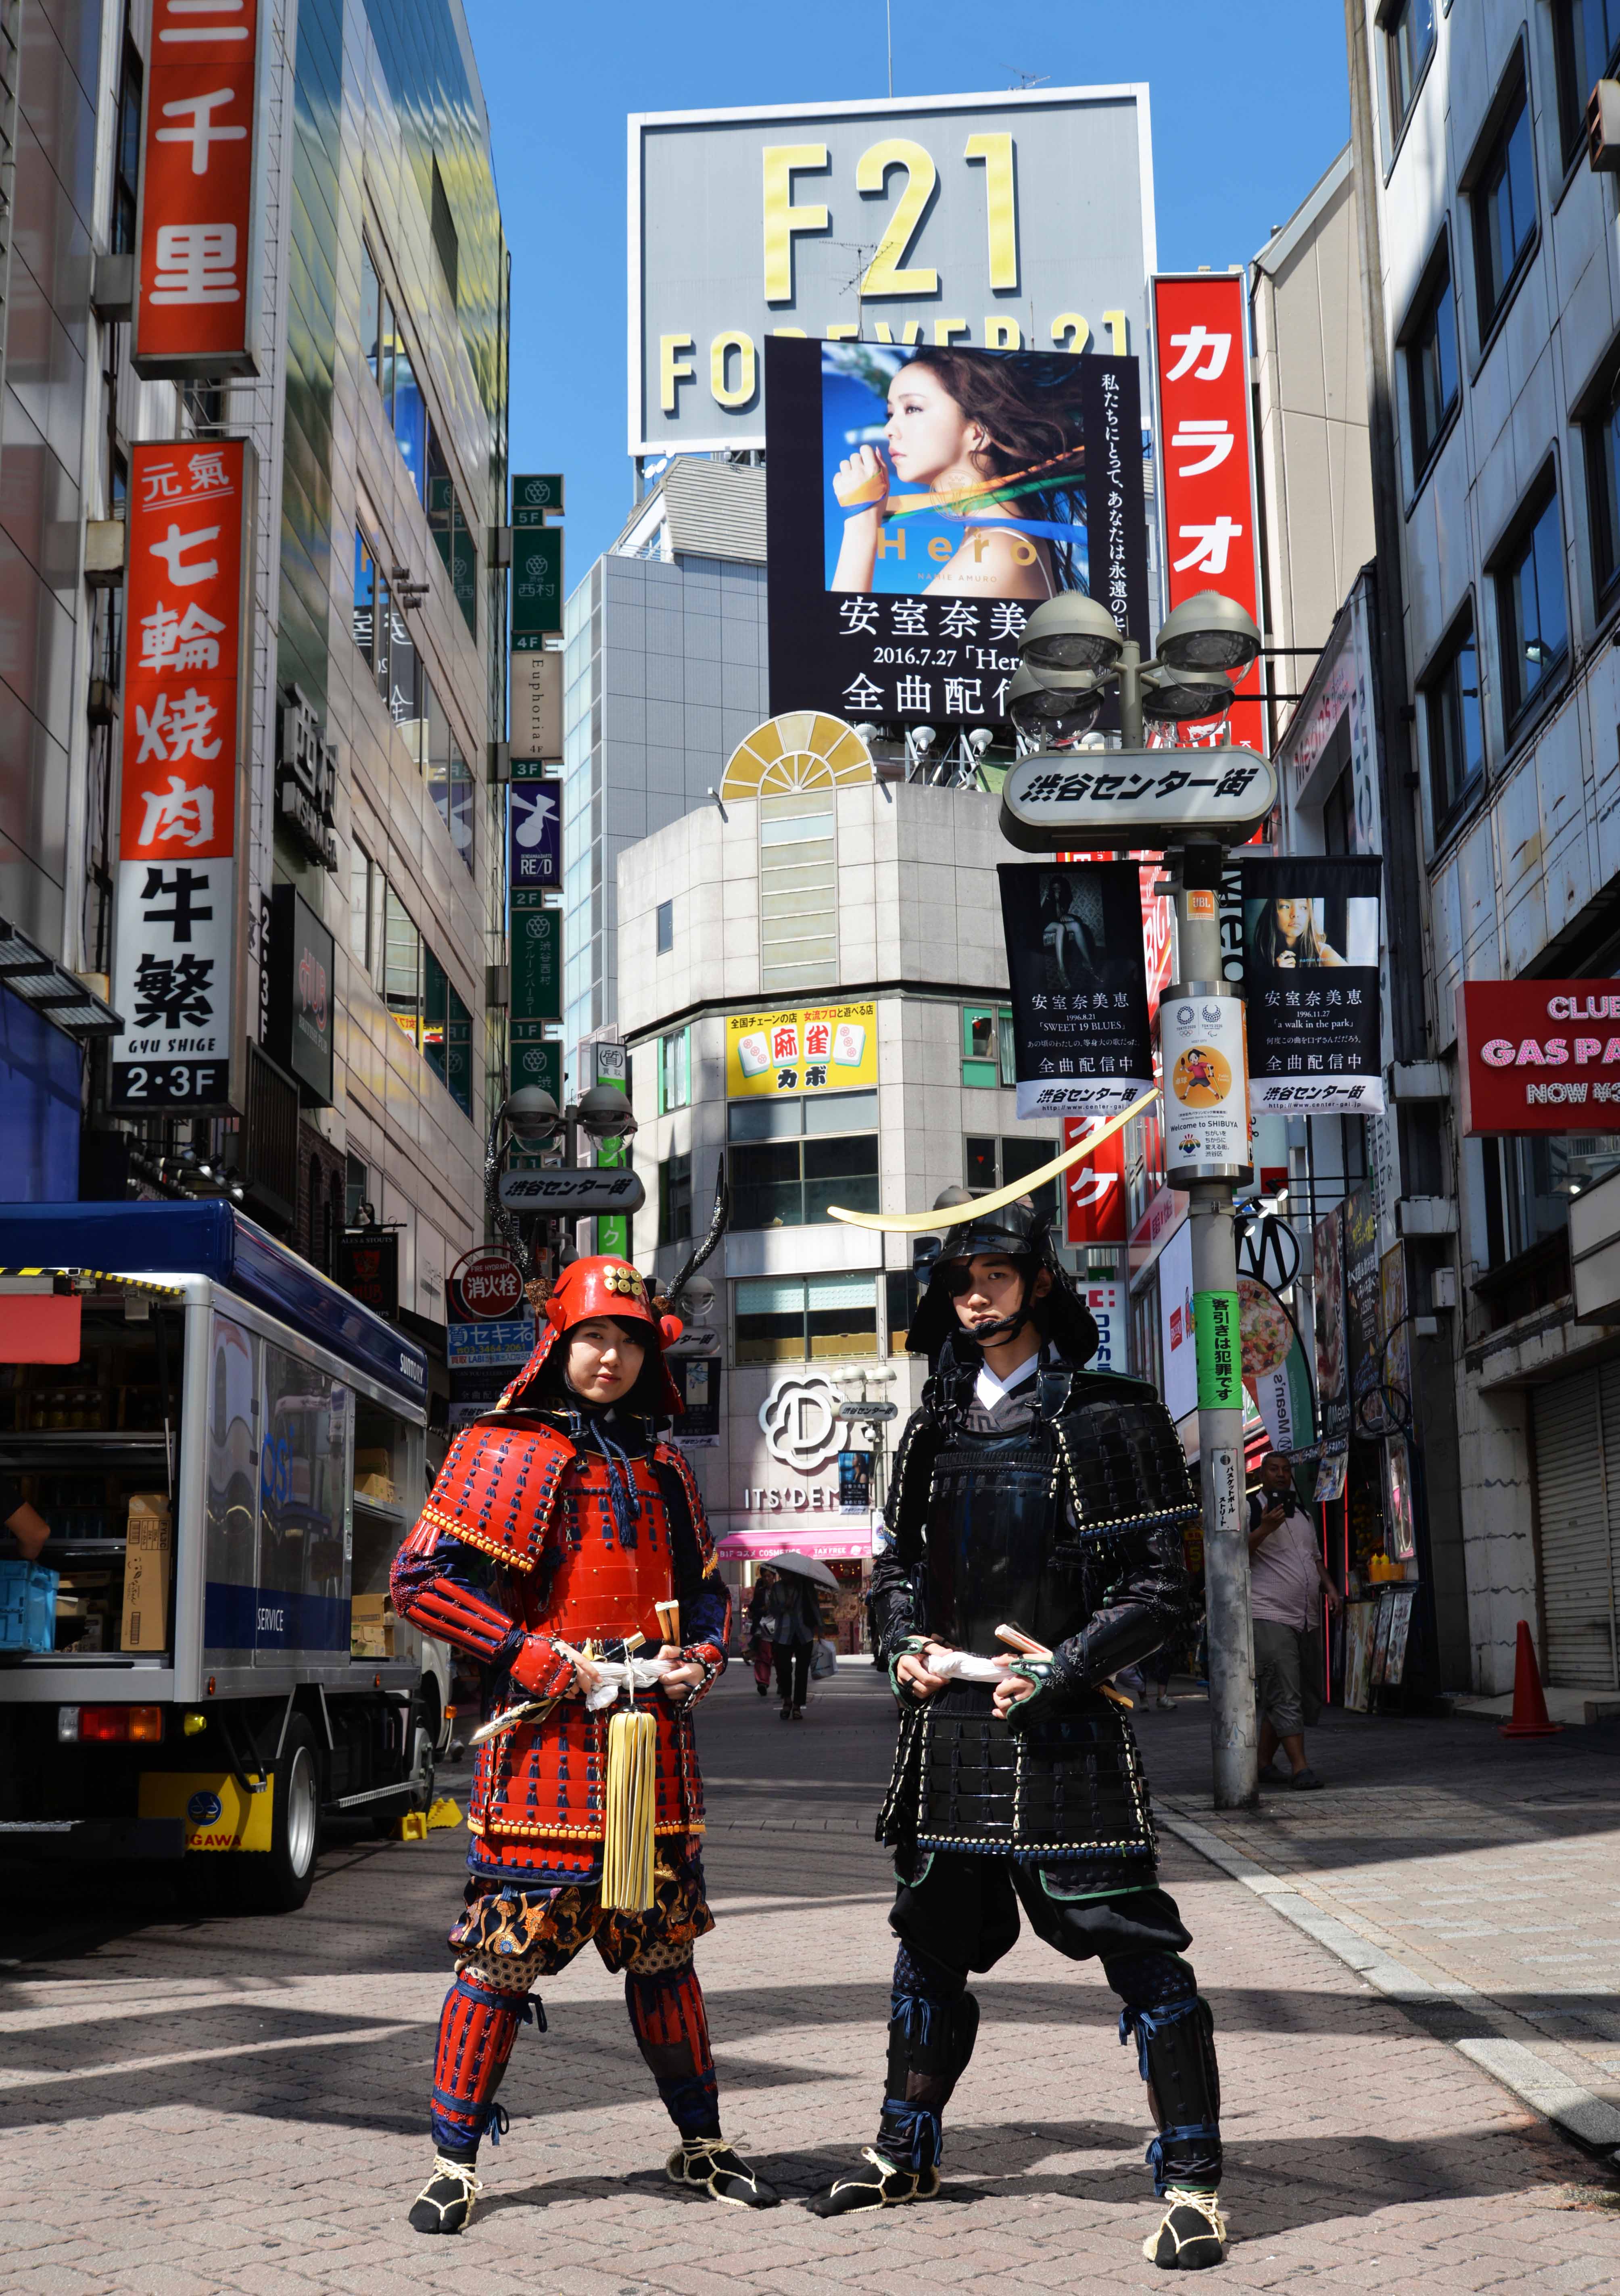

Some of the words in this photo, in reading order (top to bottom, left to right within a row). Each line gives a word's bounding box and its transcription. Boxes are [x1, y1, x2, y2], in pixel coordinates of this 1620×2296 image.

[762, 132, 1017, 303] F21
[1102, 373, 1128, 630] 私たちにとって、あなたは永遠のヒ
[519, 513, 539, 523] 5F
[877, 527, 1038, 566] Hero
[518, 583, 555, 597] 西村
[839, 595, 1028, 641] 安室奈美
[517, 637, 538, 648] 4F
[873, 646, 957, 667] 2016.7.27
[136, 523, 226, 847] 七輪焼肉
[529, 659, 544, 739] Euphoria
[517, 763, 538, 775] 3F
[1019, 768, 1260, 802] 渋谷センター街
[520, 858, 552, 875] RE/D
[517, 893, 537, 904] 2F
[132, 867, 214, 1029] 牛繁
[1031, 992, 1129, 1010] 安室奈美恵
[1264, 989, 1362, 1007] 安室奈美恵
[731, 1013, 797, 1029] 全国チェーンの店
[804, 1004, 873, 1021] 女流プロと遊べる店
[1285, 1019, 1303, 1028] walk
[1306, 1020, 1313, 1028] in
[1316, 1019, 1329, 1028] the
[517, 1025, 538, 1037] 1F
[1079, 1023, 1089, 1031] 19
[128, 1039, 160, 1053] GYU
[168, 1038, 215, 1052] SHIGE
[774, 1025, 829, 1059] 麻雀
[1038, 1056, 1133, 1073] 全曲配信中
[1265, 1053, 1362, 1071] 全曲配信中
[537, 1075, 552, 1088] 渋
[778, 1065, 827, 1088] カボ
[1036, 1088, 1138, 1104] 渋谷センター街
[1263, 1085, 1366, 1101] 渋谷センター街
[1526, 1083, 1588, 1104] NOW
[1170, 1122, 1197, 1132] Welcome
[505, 1178, 633, 1197] 渋谷センター街
[485, 1263, 510, 1271] HYDRANT
[467, 1273, 517, 1299] 消火栓
[470, 1323, 533, 1345] セキネ
[1211, 1298, 1233, 1401] 客引きは犯罪です
[842, 1407, 894, 1415] 渋谷センター街
[1225, 1467, 1236, 1513] バスケットボール
[813, 1547, 827, 1557] TAX
[828, 1547, 846, 1555] FREE
[257, 1607, 284, 1632] SERVICE
